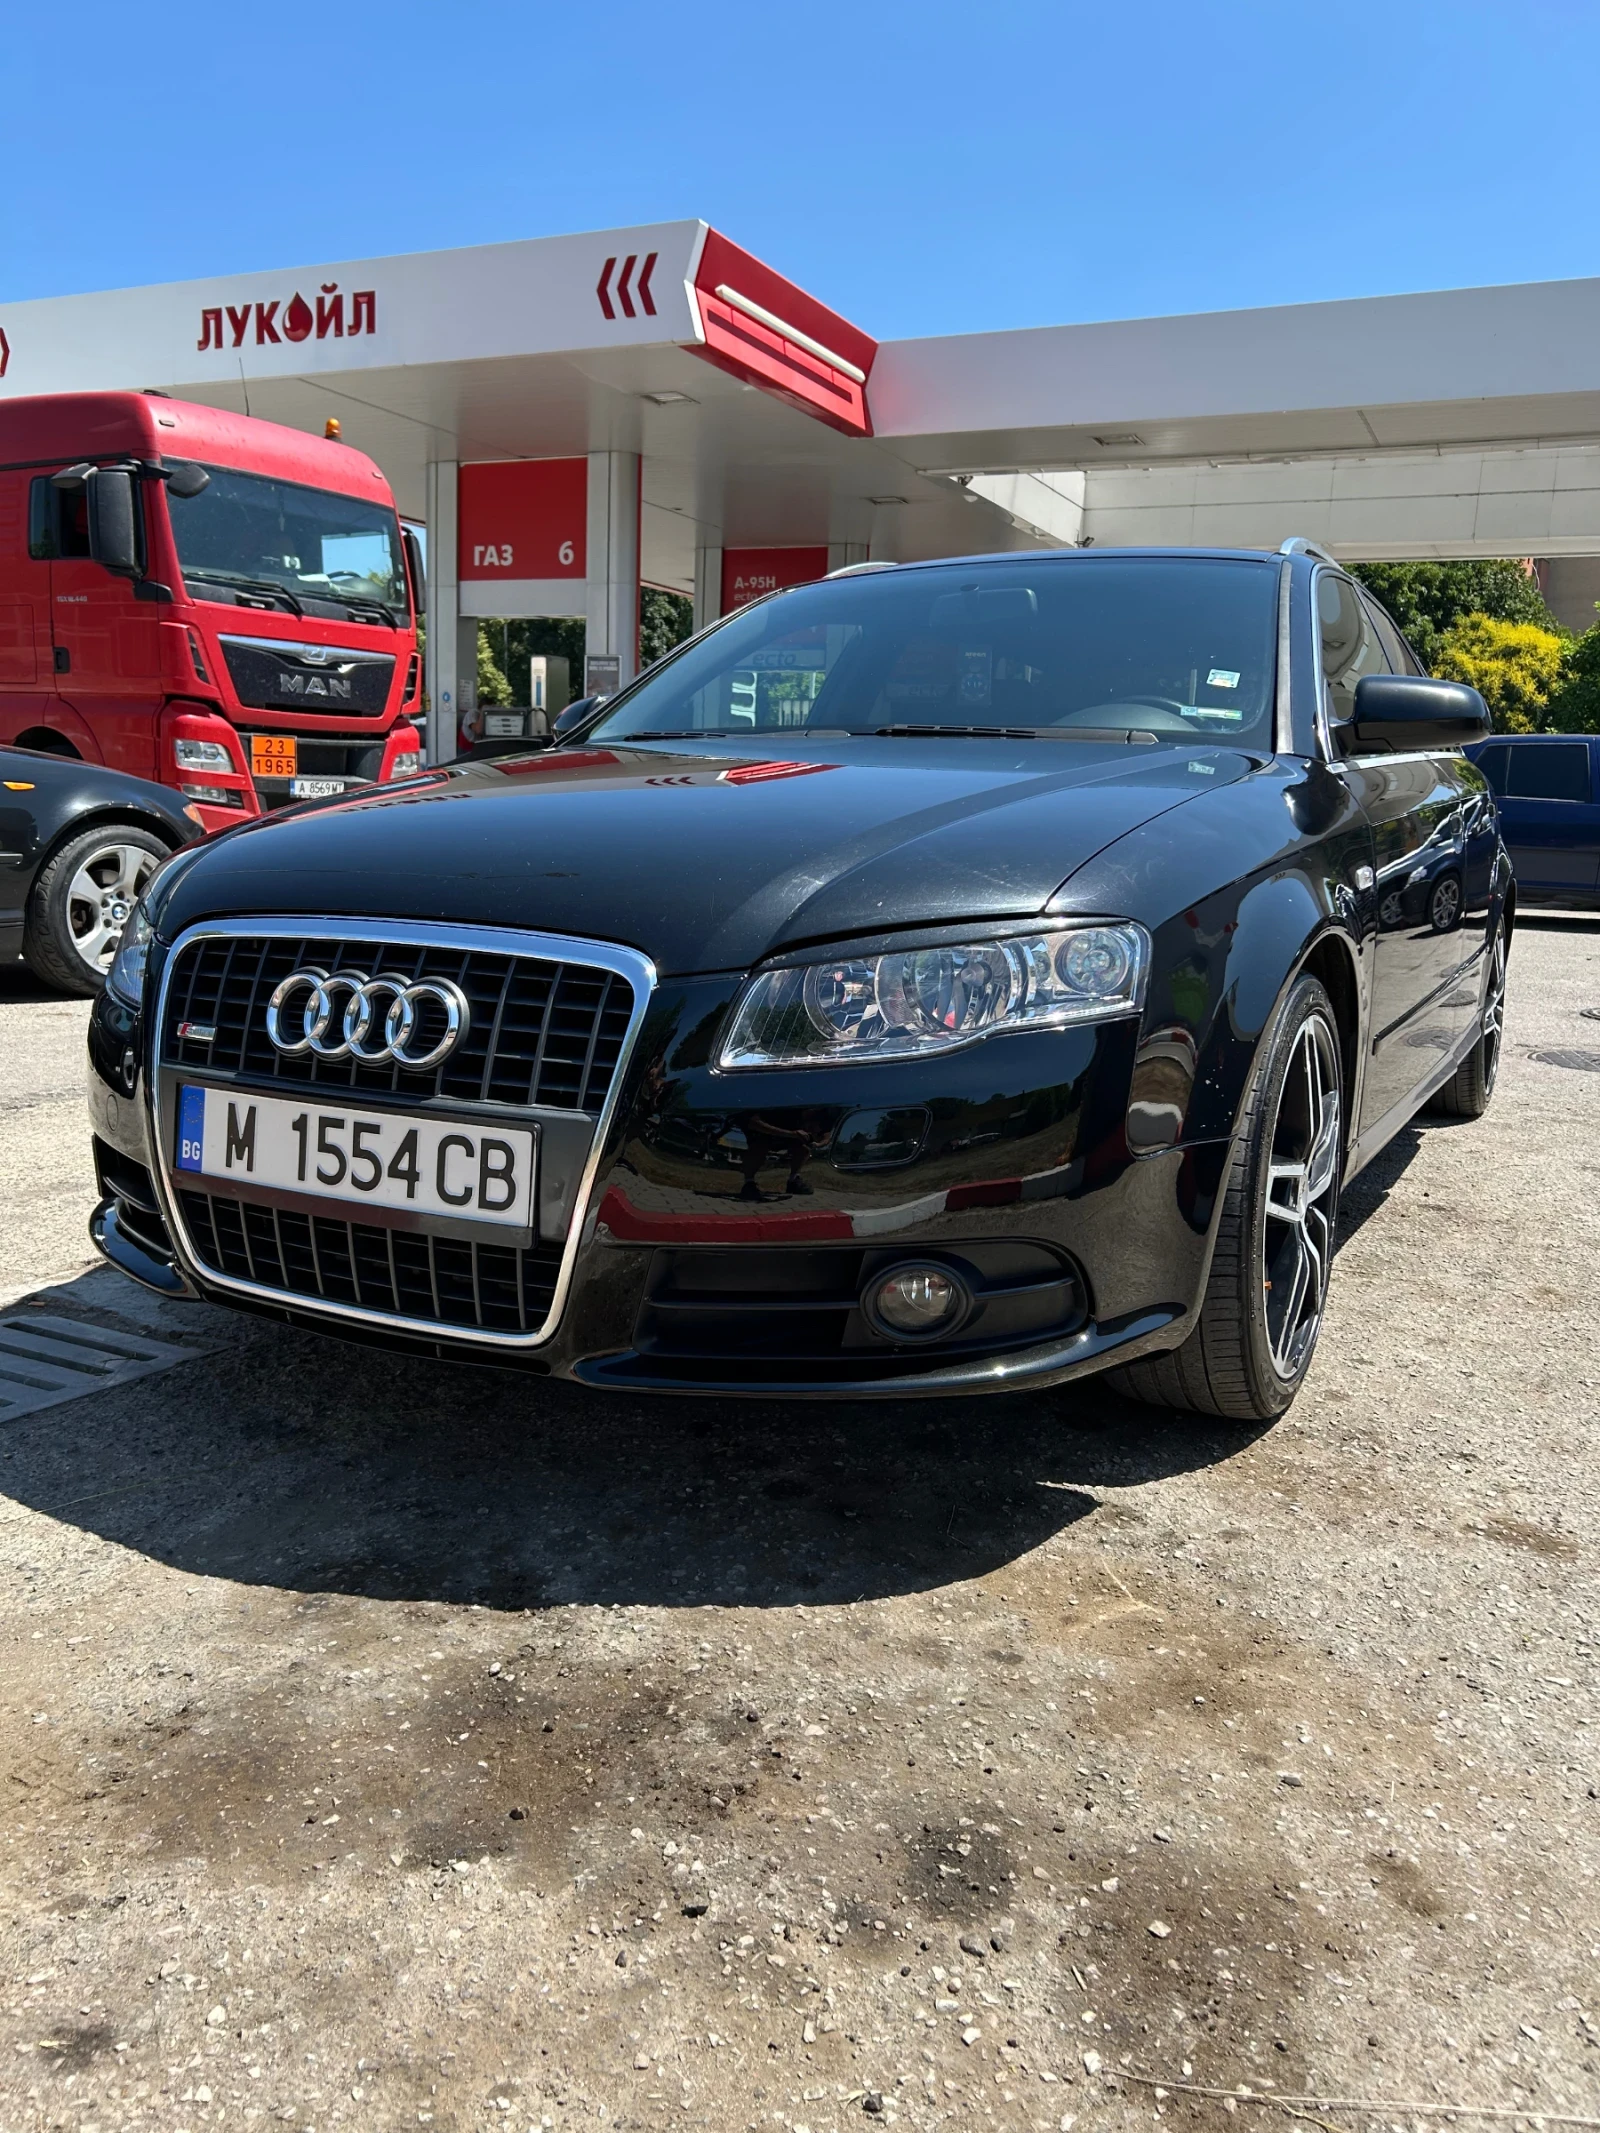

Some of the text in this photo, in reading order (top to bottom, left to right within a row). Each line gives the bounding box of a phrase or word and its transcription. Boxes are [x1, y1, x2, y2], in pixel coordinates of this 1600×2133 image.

[197, 282, 376, 351] ЛУКОЙЛ
[473, 540, 574, 566] ГАЗ 6
[753, 652, 796, 666] ecto
[280, 673, 351, 698] MAN
[265, 739, 284, 754] 23
[256, 759, 294, 774] 1965
[299, 782, 305, 793] A
[182, 1140, 200, 1161] BG
[225, 1103, 517, 1212] M 1554 CB
